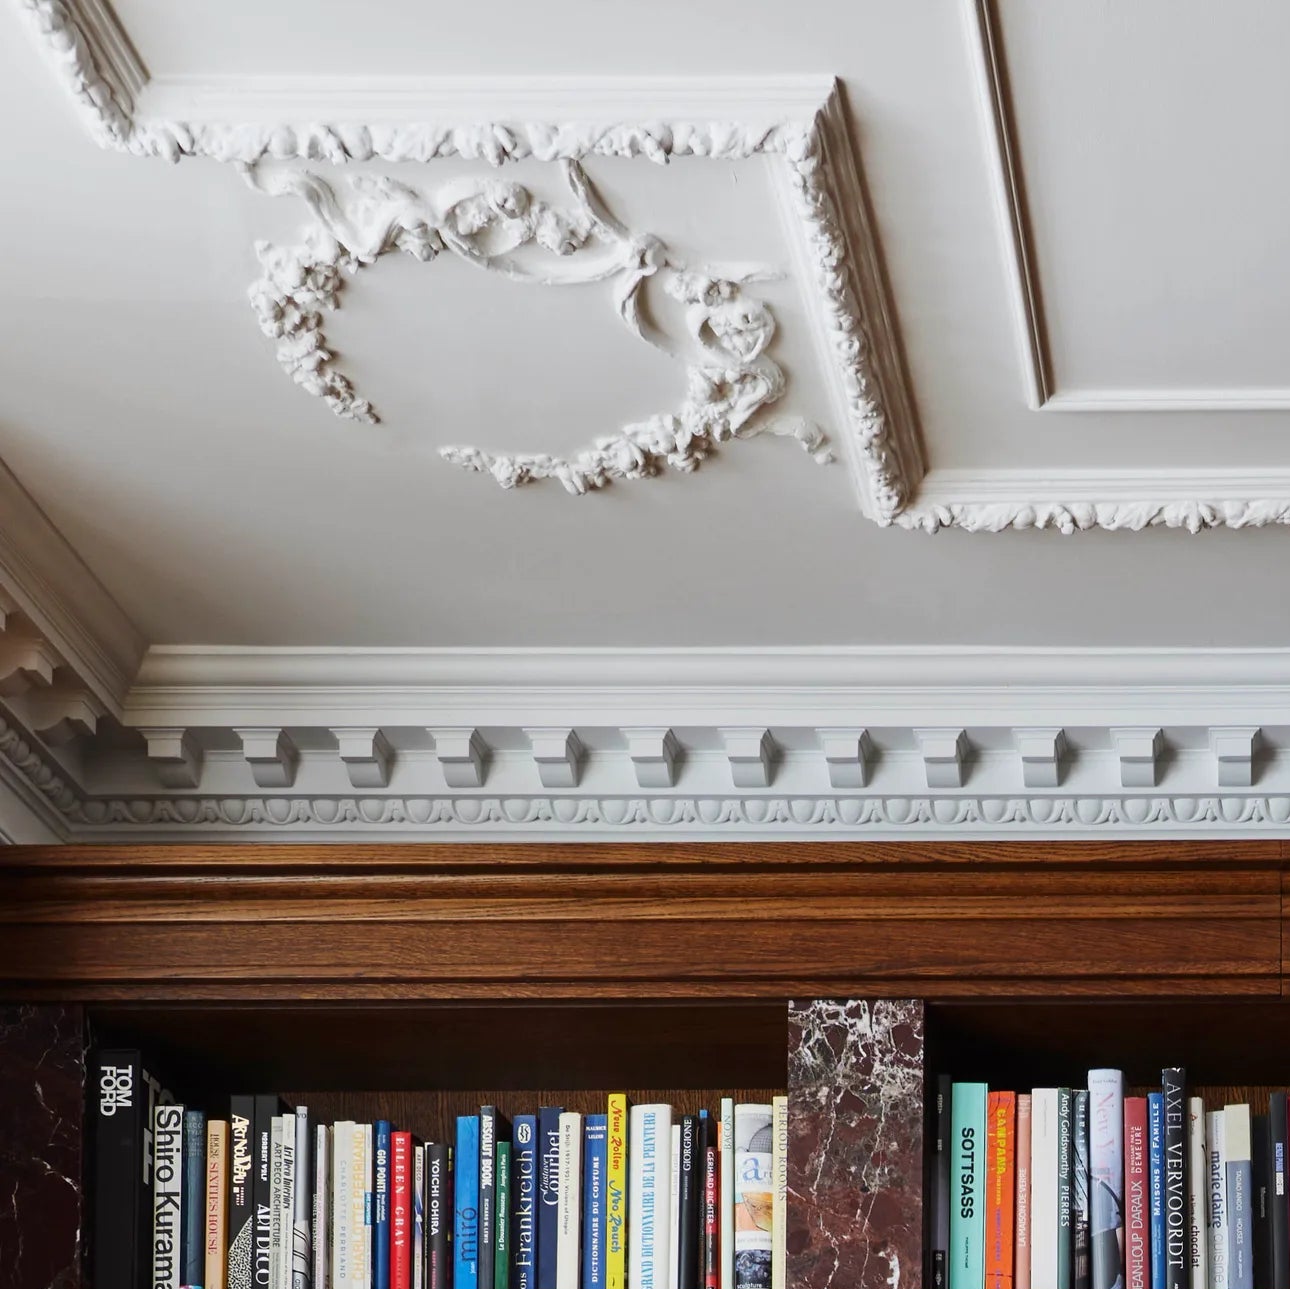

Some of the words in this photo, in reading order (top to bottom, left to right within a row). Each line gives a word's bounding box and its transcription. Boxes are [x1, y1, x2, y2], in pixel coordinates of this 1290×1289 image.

[100, 1066, 116, 1116] FORD
[117, 1065, 132, 1107] TOM
[1059, 1094, 1069, 1117] Andy
[1167, 1082, 1181, 1135] AXEL
[155, 1109, 180, 1183] Shiro
[396, 1138, 404, 1194] EILEEN
[683, 1119, 692, 1171] GIORGIONE
[1060, 1120, 1070, 1179] Goldsworthy
[208, 1162, 218, 1212] SIXTIES
[706, 1151, 714, 1188] GERHARD
[961, 1127, 974, 1218] SOTTSASS
[1210, 1151, 1222, 1190] marie
[395, 1206, 404, 1247] GRAY
[706, 1190, 714, 1223] RICHTER
[1061, 1186, 1069, 1227] PIERRES
[1168, 1142, 1183, 1269] VERVOORDT
[1211, 1193, 1223, 1228] claire
[207, 1214, 218, 1255] HOUSE
